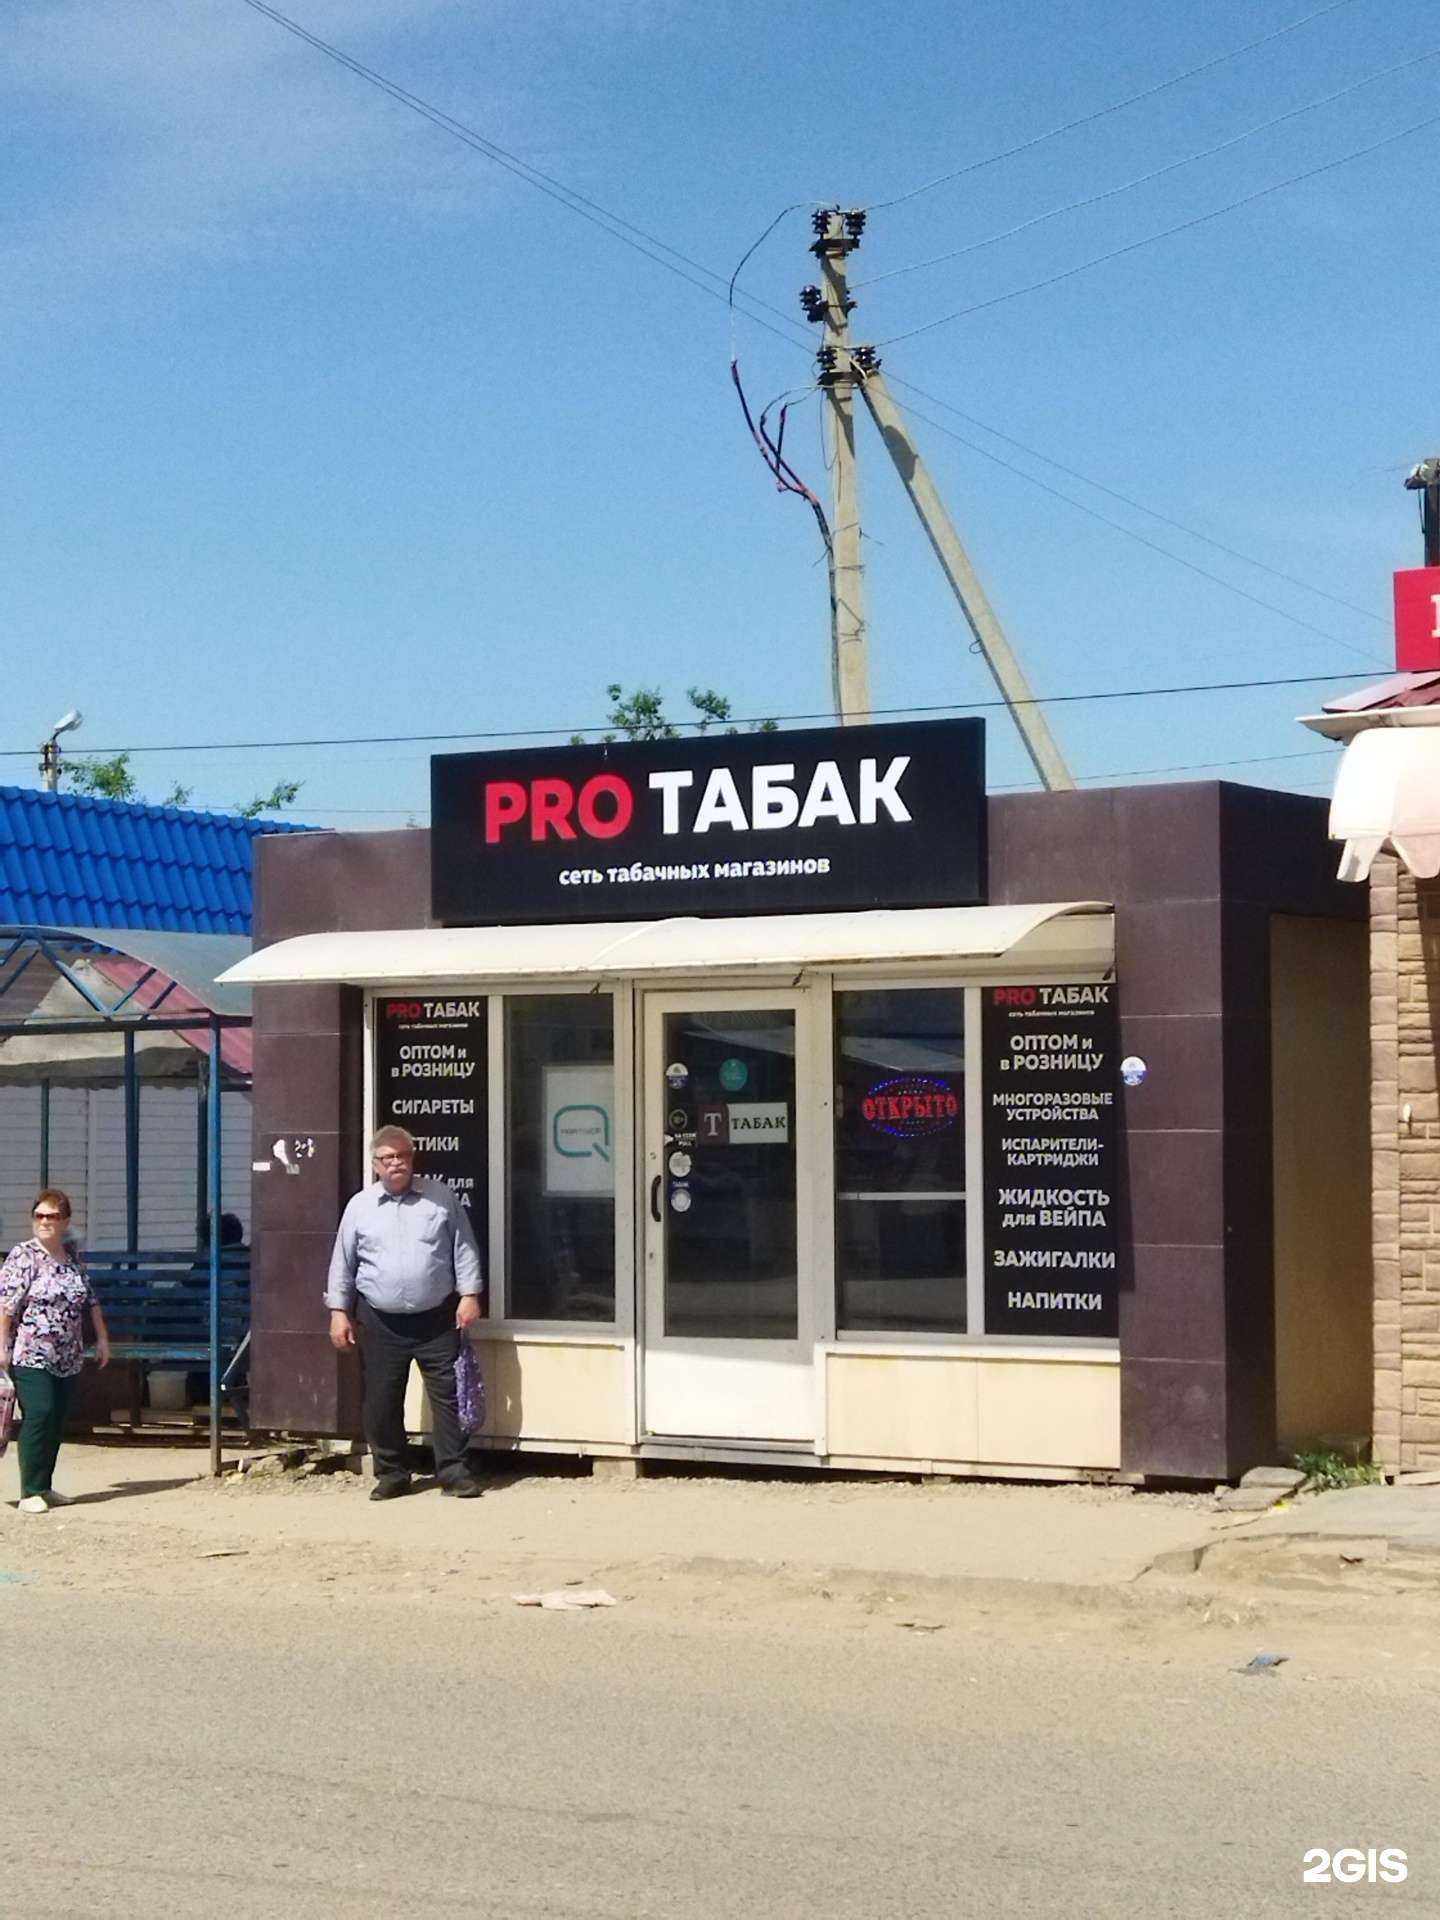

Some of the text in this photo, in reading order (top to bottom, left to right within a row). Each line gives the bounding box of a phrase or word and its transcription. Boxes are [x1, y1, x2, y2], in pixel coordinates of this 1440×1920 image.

[484, 755, 913, 844] PRO ТАБАК
[558, 856, 831, 886] сеть табачных магазинов
[992, 986, 1109, 1005] PRO ТАБАК
[387, 1001, 480, 1019] PRO ТАБАК
[1010, 1034, 1093, 1051] ОПТОМ и
[399, 1045, 467, 1060] ОПТОМ и
[391, 1062, 476, 1080] в РОЗНИЦУ
[1000, 1054, 1104, 1072] в РОЗНИЦУ
[392, 1099, 475, 1115] СИГАРЕТЫ
[862, 1094, 958, 1120] ОТКРЫТО
[993, 1093, 1113, 1106] МНОГОРАЗОВЫЕ
[1007, 1106, 1100, 1121] УСТРОЙСТВА
[731, 1116, 786, 1130] ТАБАК
[1001, 1138, 1104, 1150] ИСПАРИТЕЛИ-
[1007, 1153, 1099, 1167] КАРТРИДЖИ
[999, 1188, 1111, 1208] ЖИДКОСТЬ
[1002, 1206, 1107, 1228] для ВЕЙПА
[993, 1250, 1116, 1269] ЗАЖИГАЛКИ
[1008, 1291, 1102, 1311] НАПИТКИ
